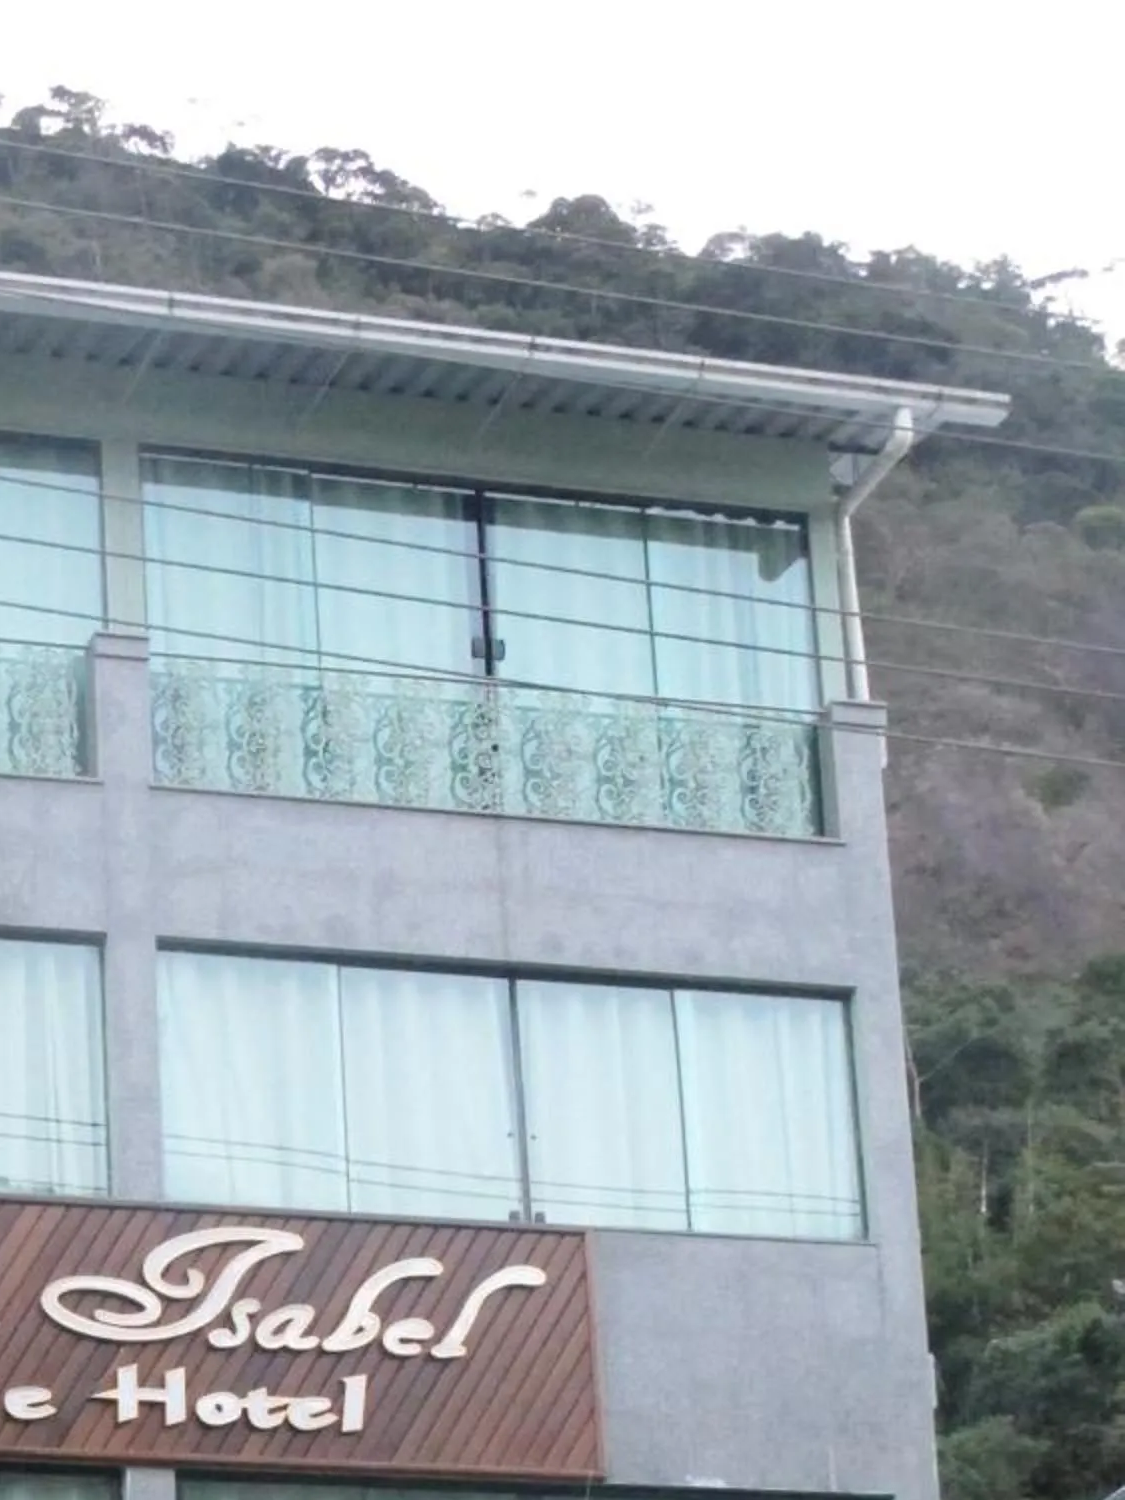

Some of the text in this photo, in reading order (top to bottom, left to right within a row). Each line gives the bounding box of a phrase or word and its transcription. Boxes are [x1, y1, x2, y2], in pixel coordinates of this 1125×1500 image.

[41, 1226, 547, 1358] Isabel
[4, 1384, 57, 1420] e
[92, 1363, 367, 1433] Hotel
